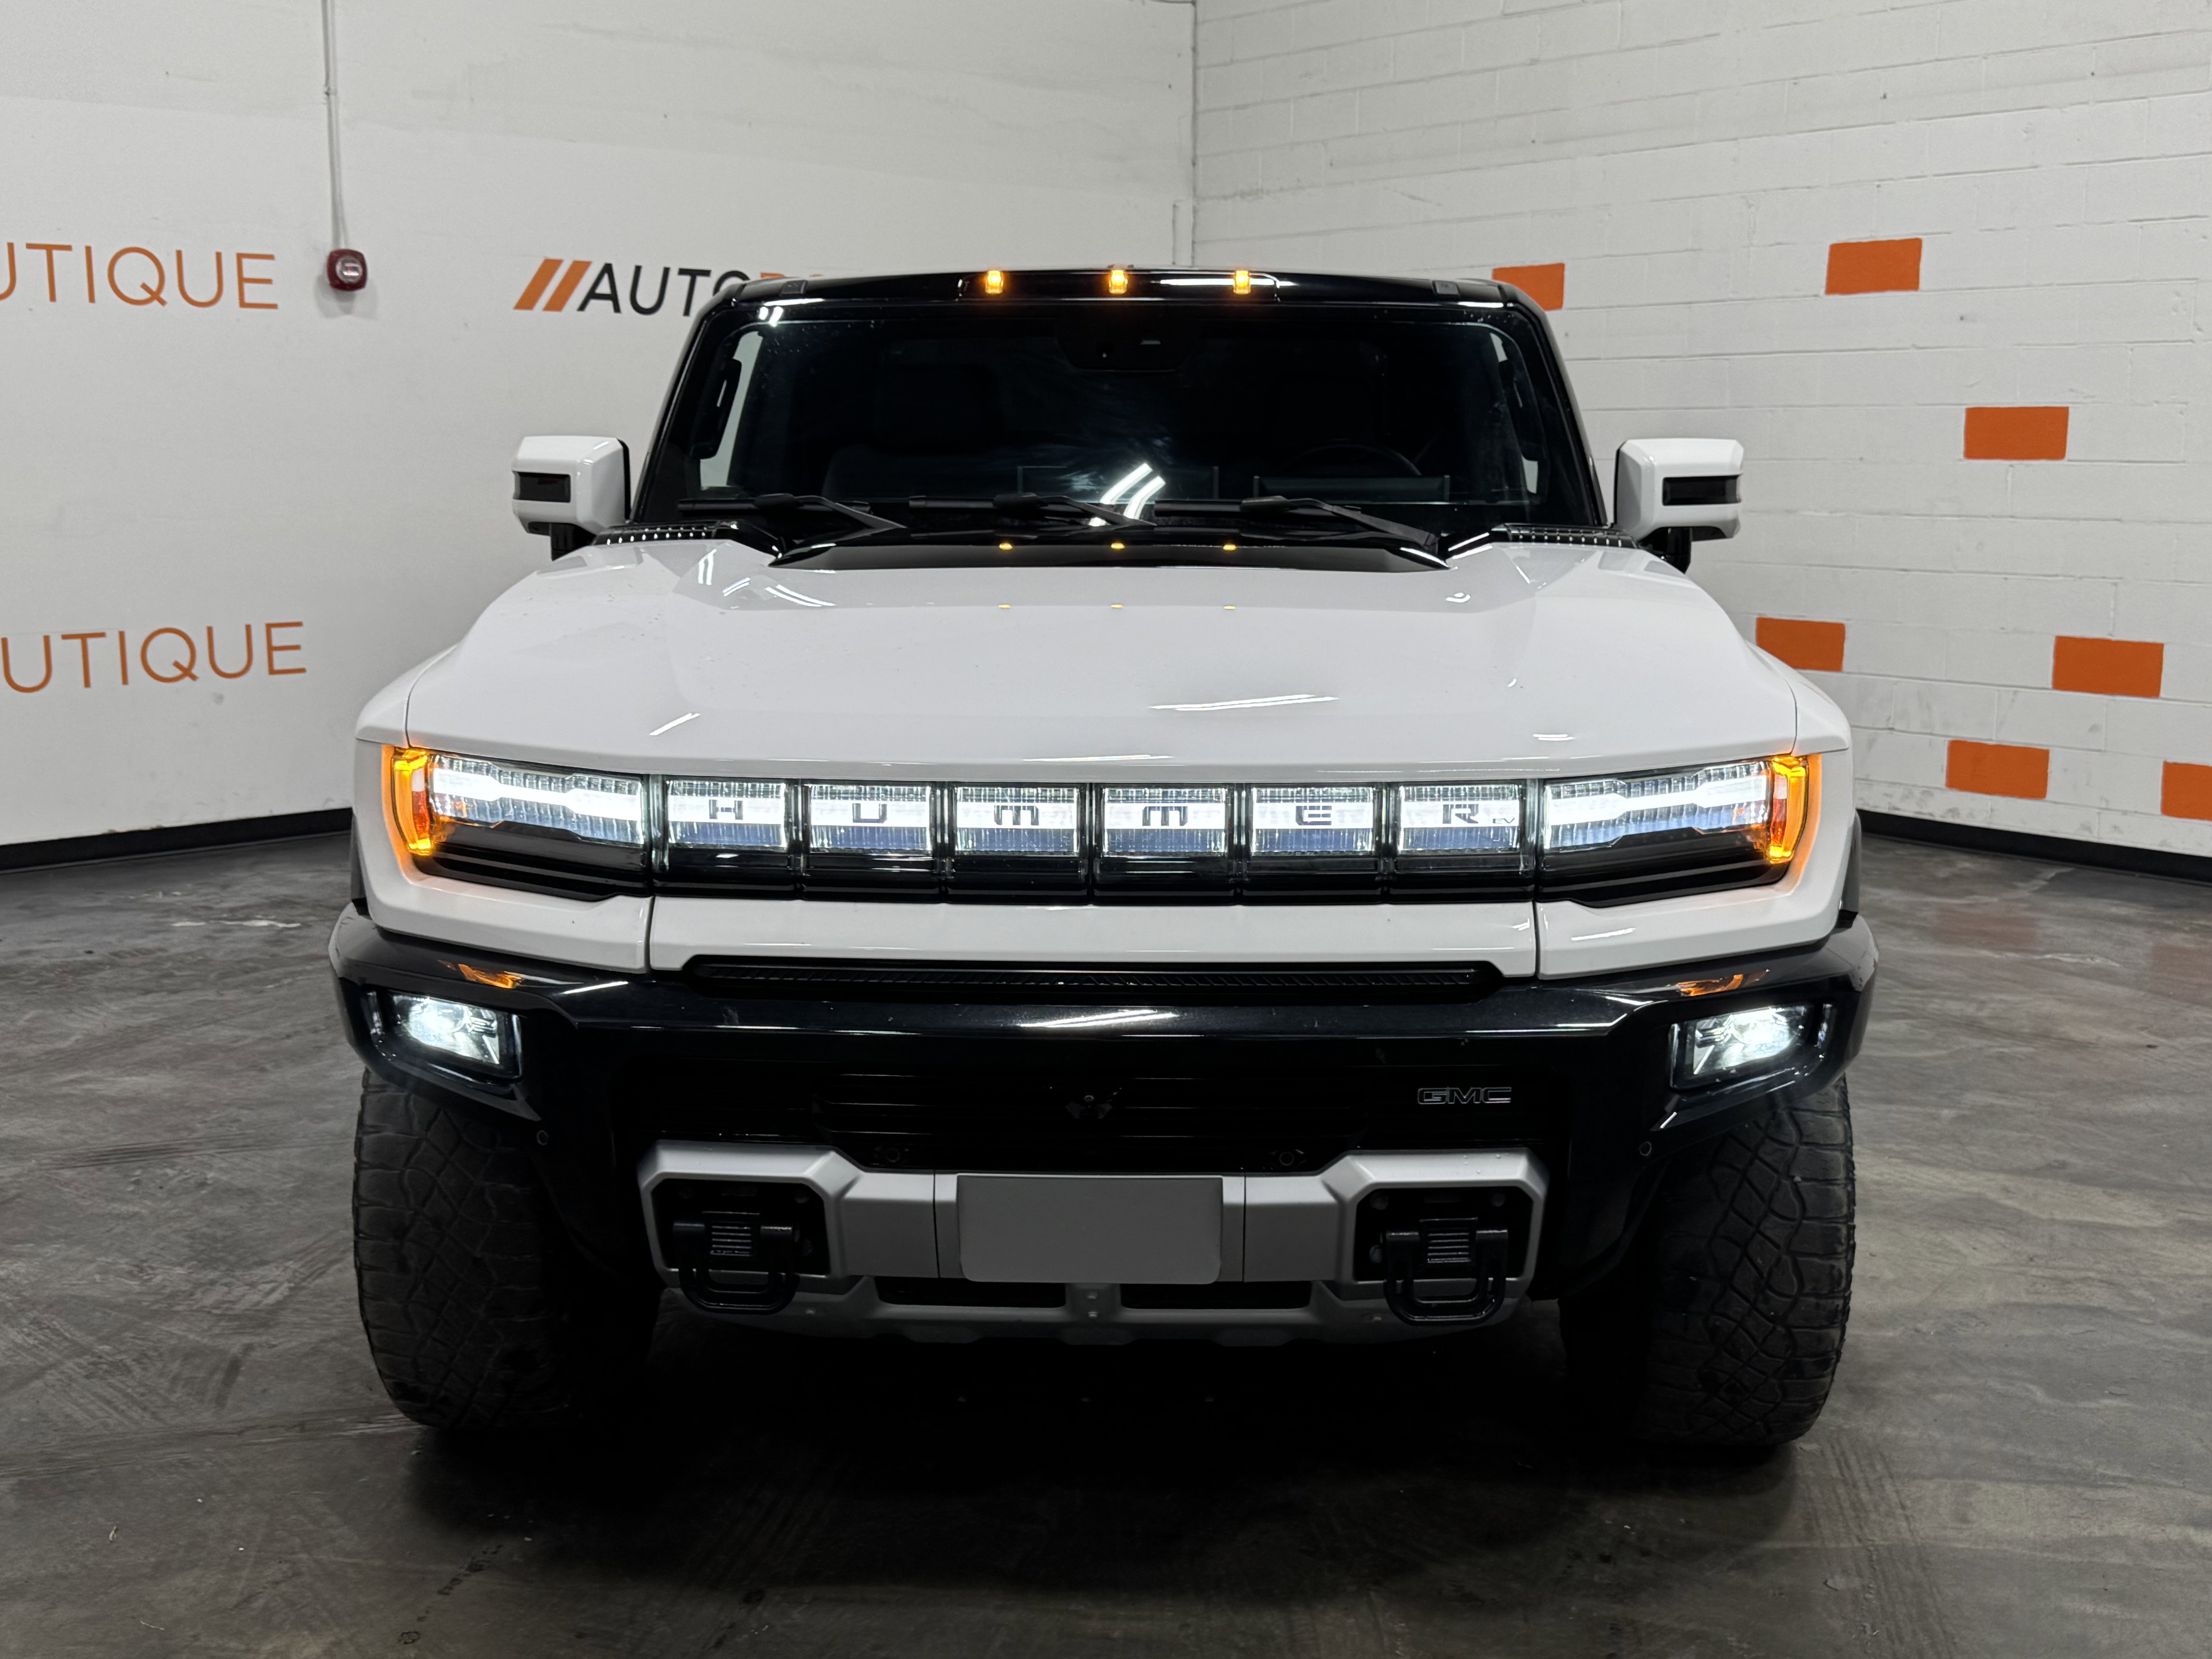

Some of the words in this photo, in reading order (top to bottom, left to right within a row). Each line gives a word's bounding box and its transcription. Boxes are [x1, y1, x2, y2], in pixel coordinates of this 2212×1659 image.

[1, 622, 307, 693] UTIQUE
[708, 799, 1479, 827] HUMMER
[1417, 1087, 1512, 1104] GMC
